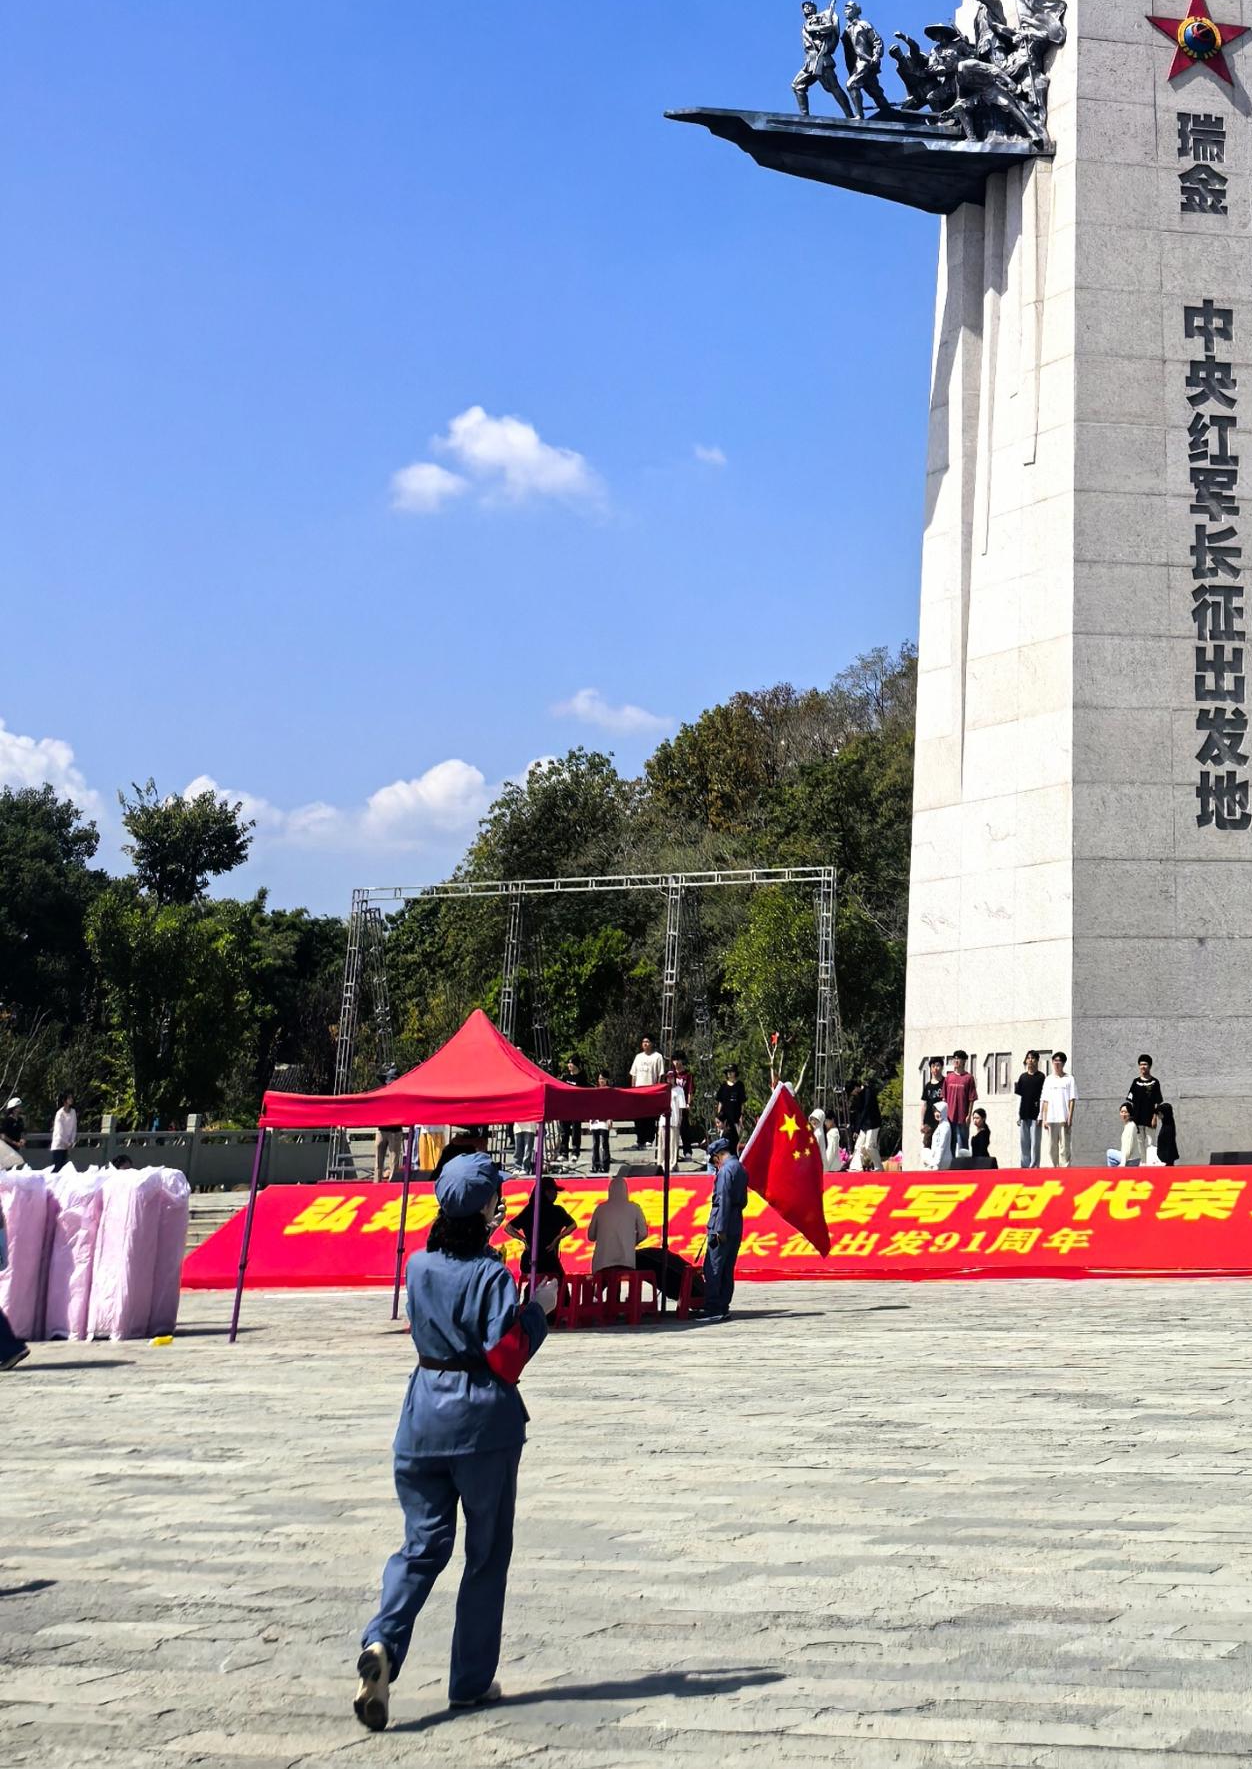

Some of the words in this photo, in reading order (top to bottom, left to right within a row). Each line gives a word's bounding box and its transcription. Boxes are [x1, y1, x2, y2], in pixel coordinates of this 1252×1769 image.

[1176, 111, 1229, 216] 瑞金
[1183, 298, 1252, 832] 中央红军长征出发地
